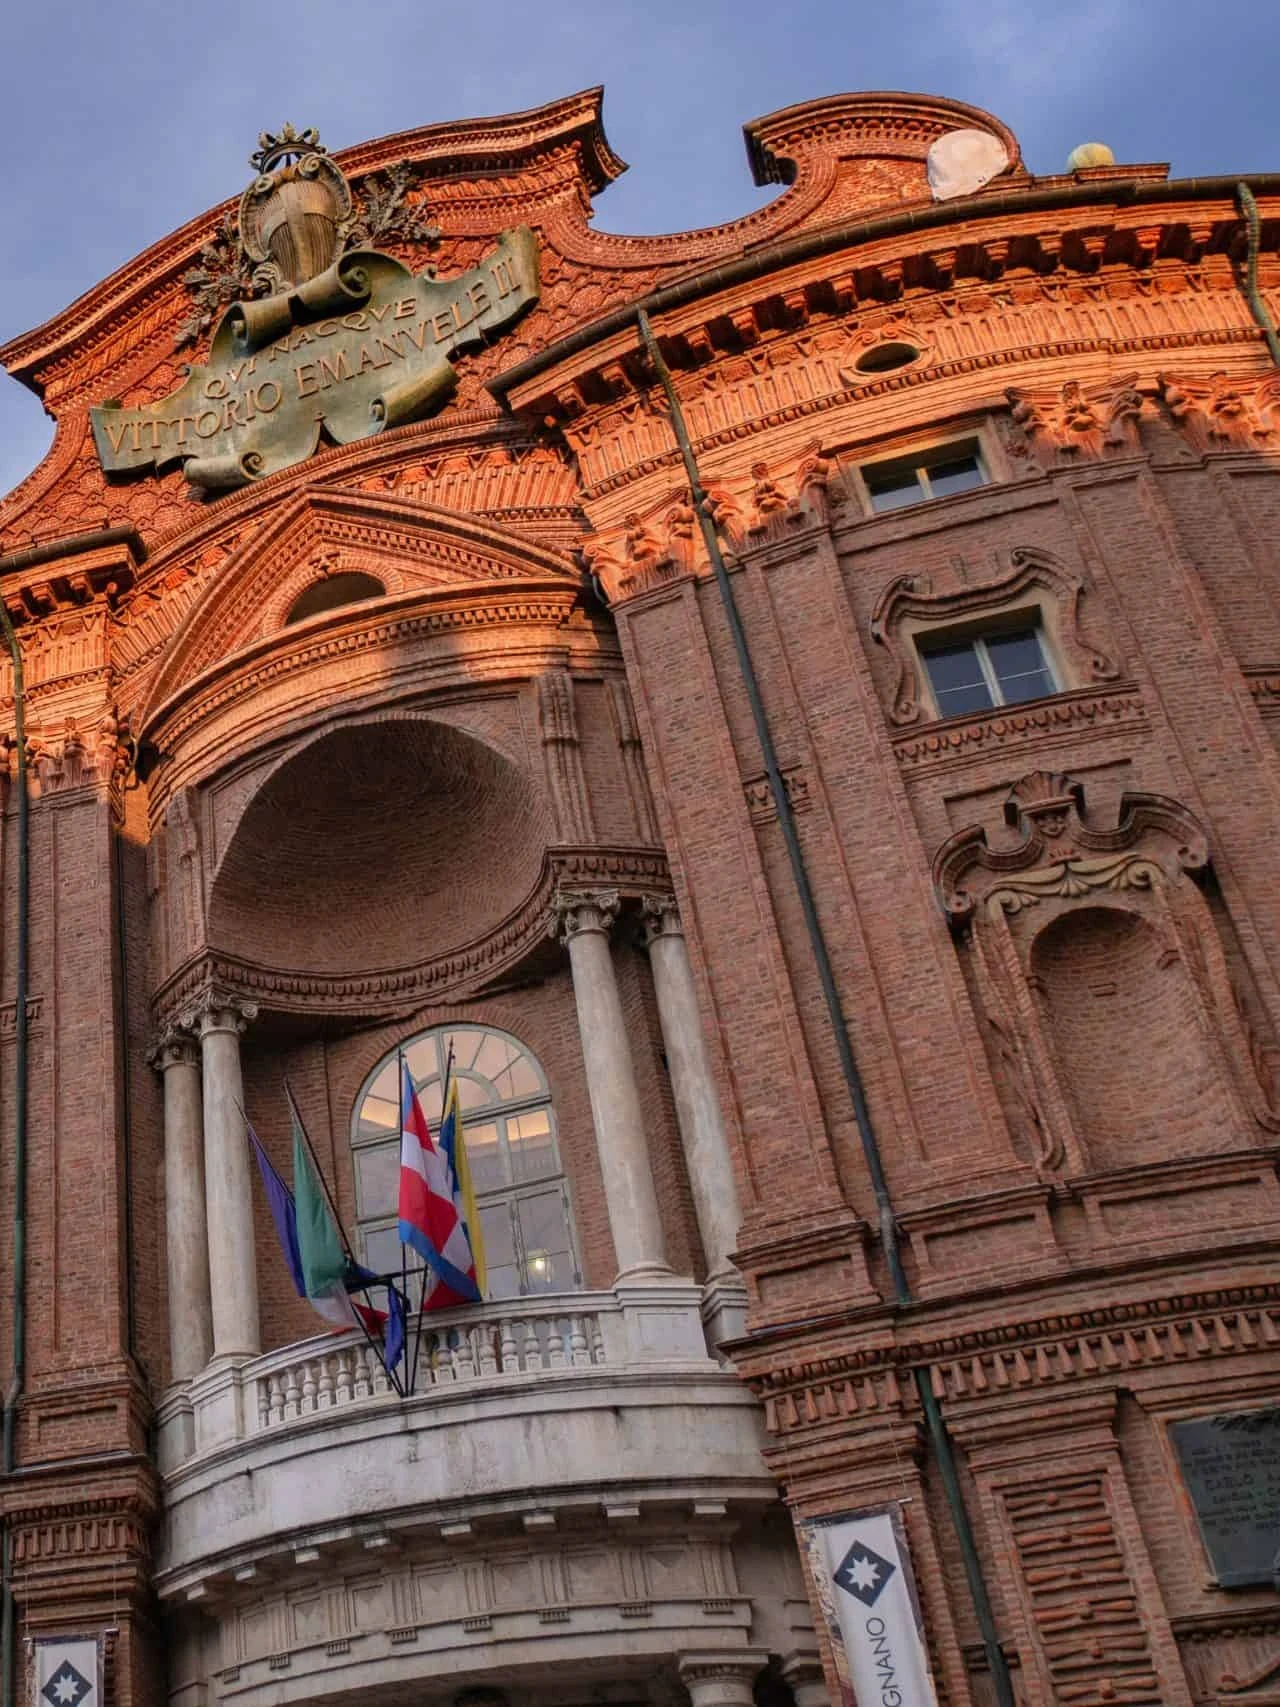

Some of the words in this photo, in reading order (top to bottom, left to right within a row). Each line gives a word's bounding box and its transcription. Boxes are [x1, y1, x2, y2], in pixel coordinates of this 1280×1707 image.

[104, 380, 283, 454] VITTORIO
[296, 280, 492, 399] EMANVELE
[490, 257, 522, 299] II
[205, 357, 257, 400] QVI
[270, 296, 417, 360] NACQVE
